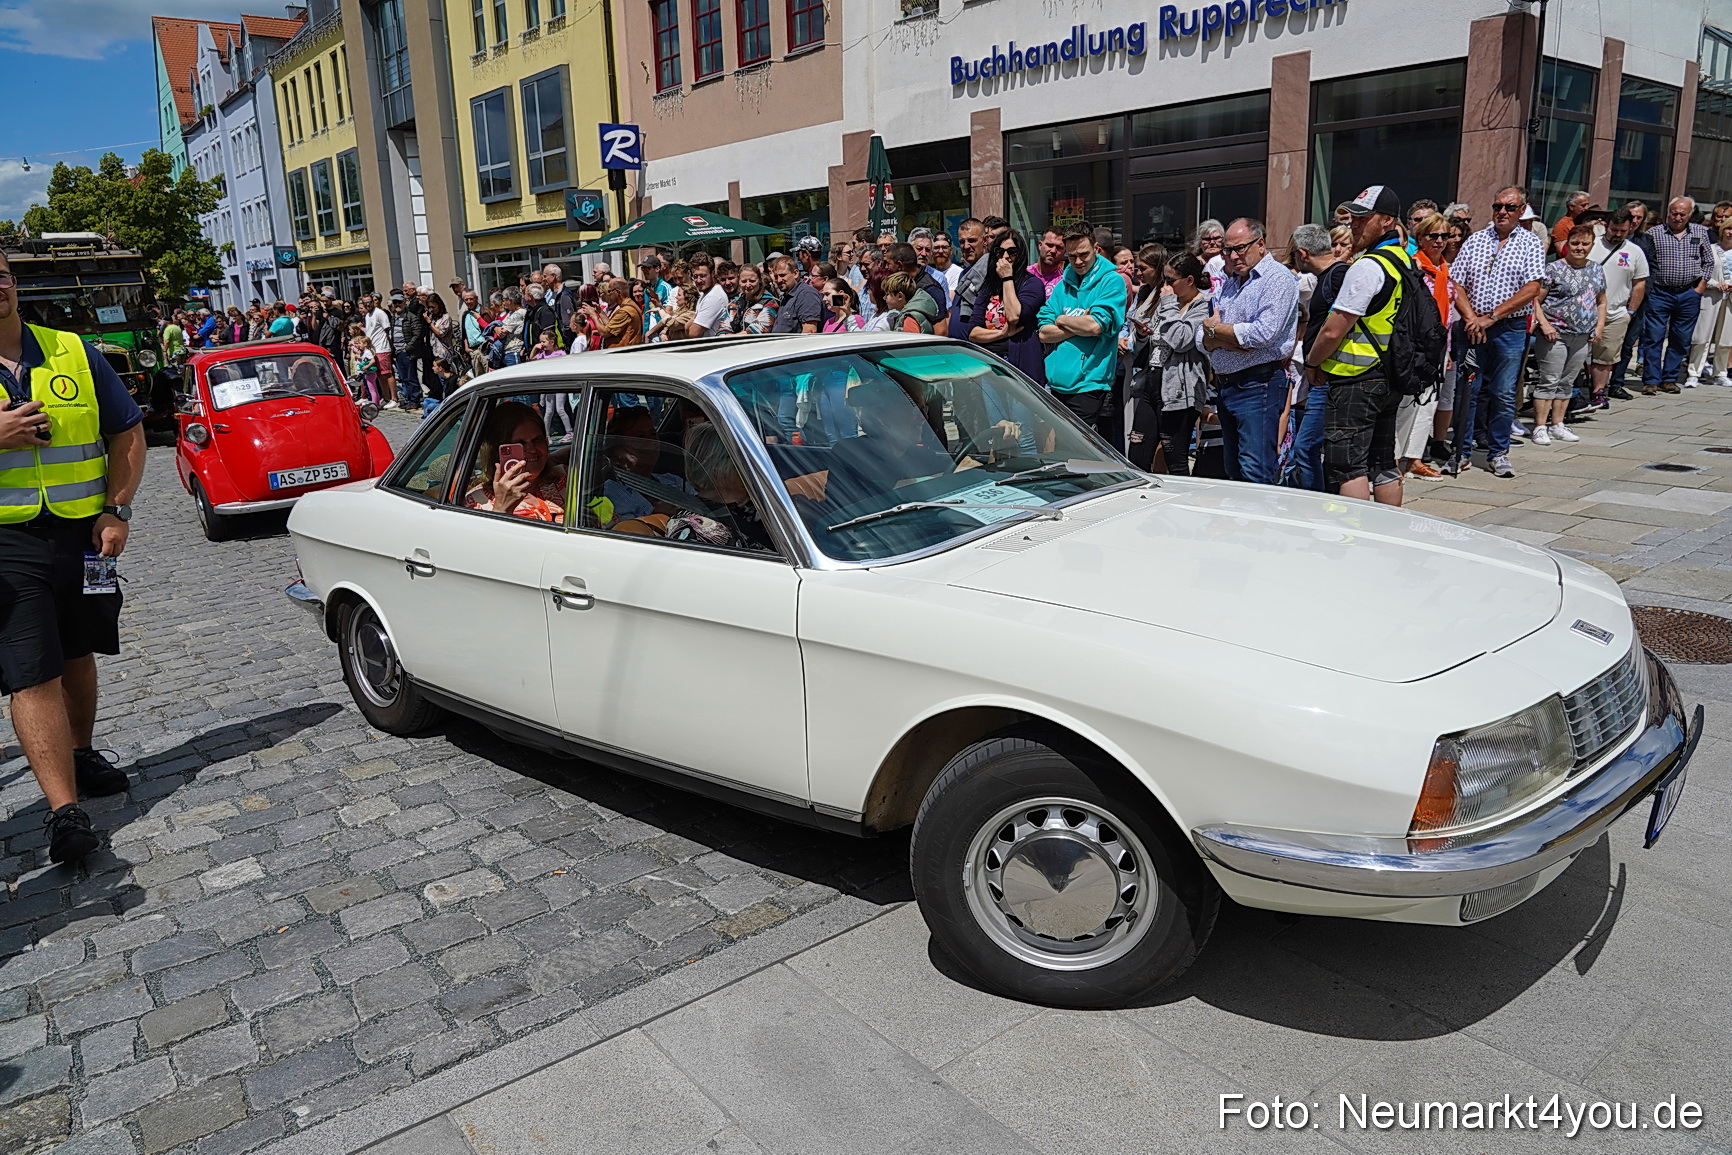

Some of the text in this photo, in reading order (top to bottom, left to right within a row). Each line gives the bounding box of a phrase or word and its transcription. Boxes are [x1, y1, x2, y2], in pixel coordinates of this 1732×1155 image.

[951, 22, 1146, 85] Buchhandlung
[660, 179, 671, 188] Markt
[671, 177, 677, 186] 15
[581, 200, 595, 218] G2
[235, 383, 252, 392] 529
[280, 472, 297, 487] AS
[304, 469, 321, 483] ZP
[323, 466, 339, 480] 55
[974, 488, 1004, 500] 536
